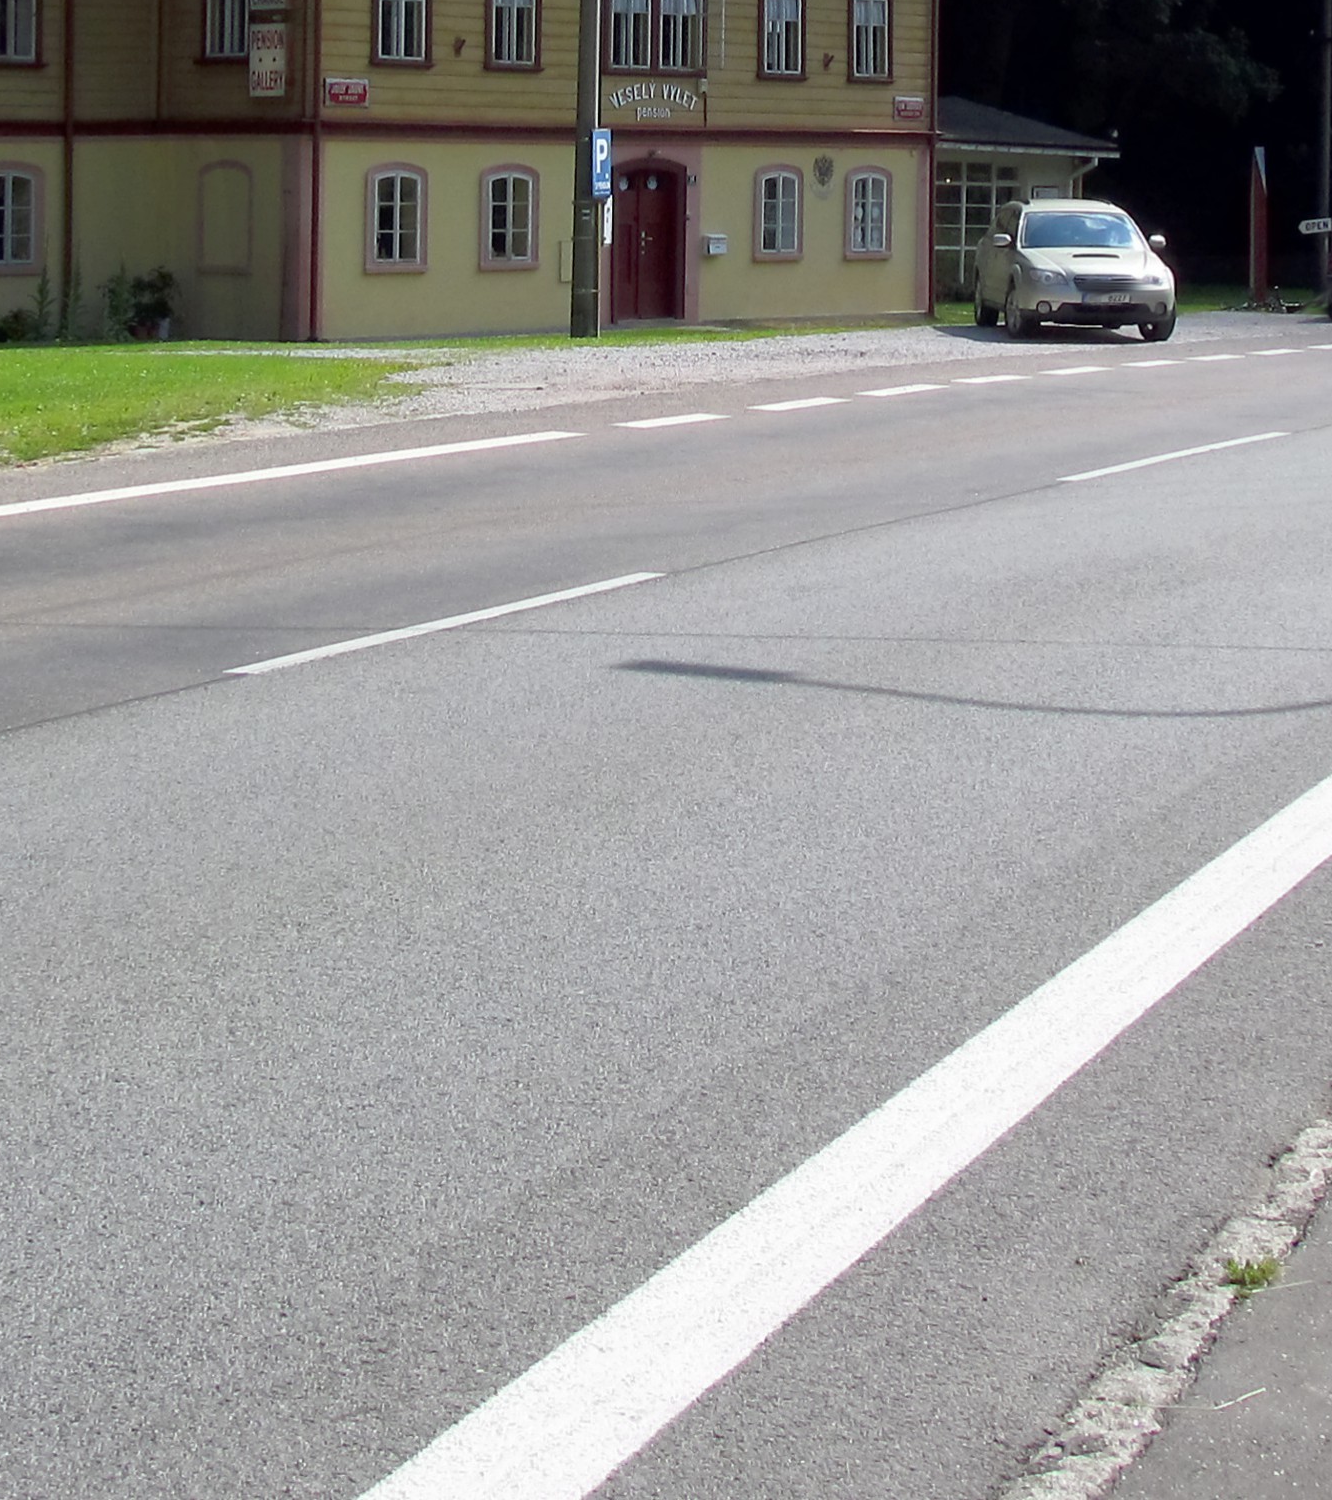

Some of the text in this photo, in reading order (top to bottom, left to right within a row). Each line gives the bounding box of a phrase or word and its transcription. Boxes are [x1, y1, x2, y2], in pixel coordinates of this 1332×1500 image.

[252, 30, 284, 50] PENSION
[251, 70, 284, 91] GALLERY
[637, 106, 671, 121] pension
[1305, 220, 1329, 231] OPEN
